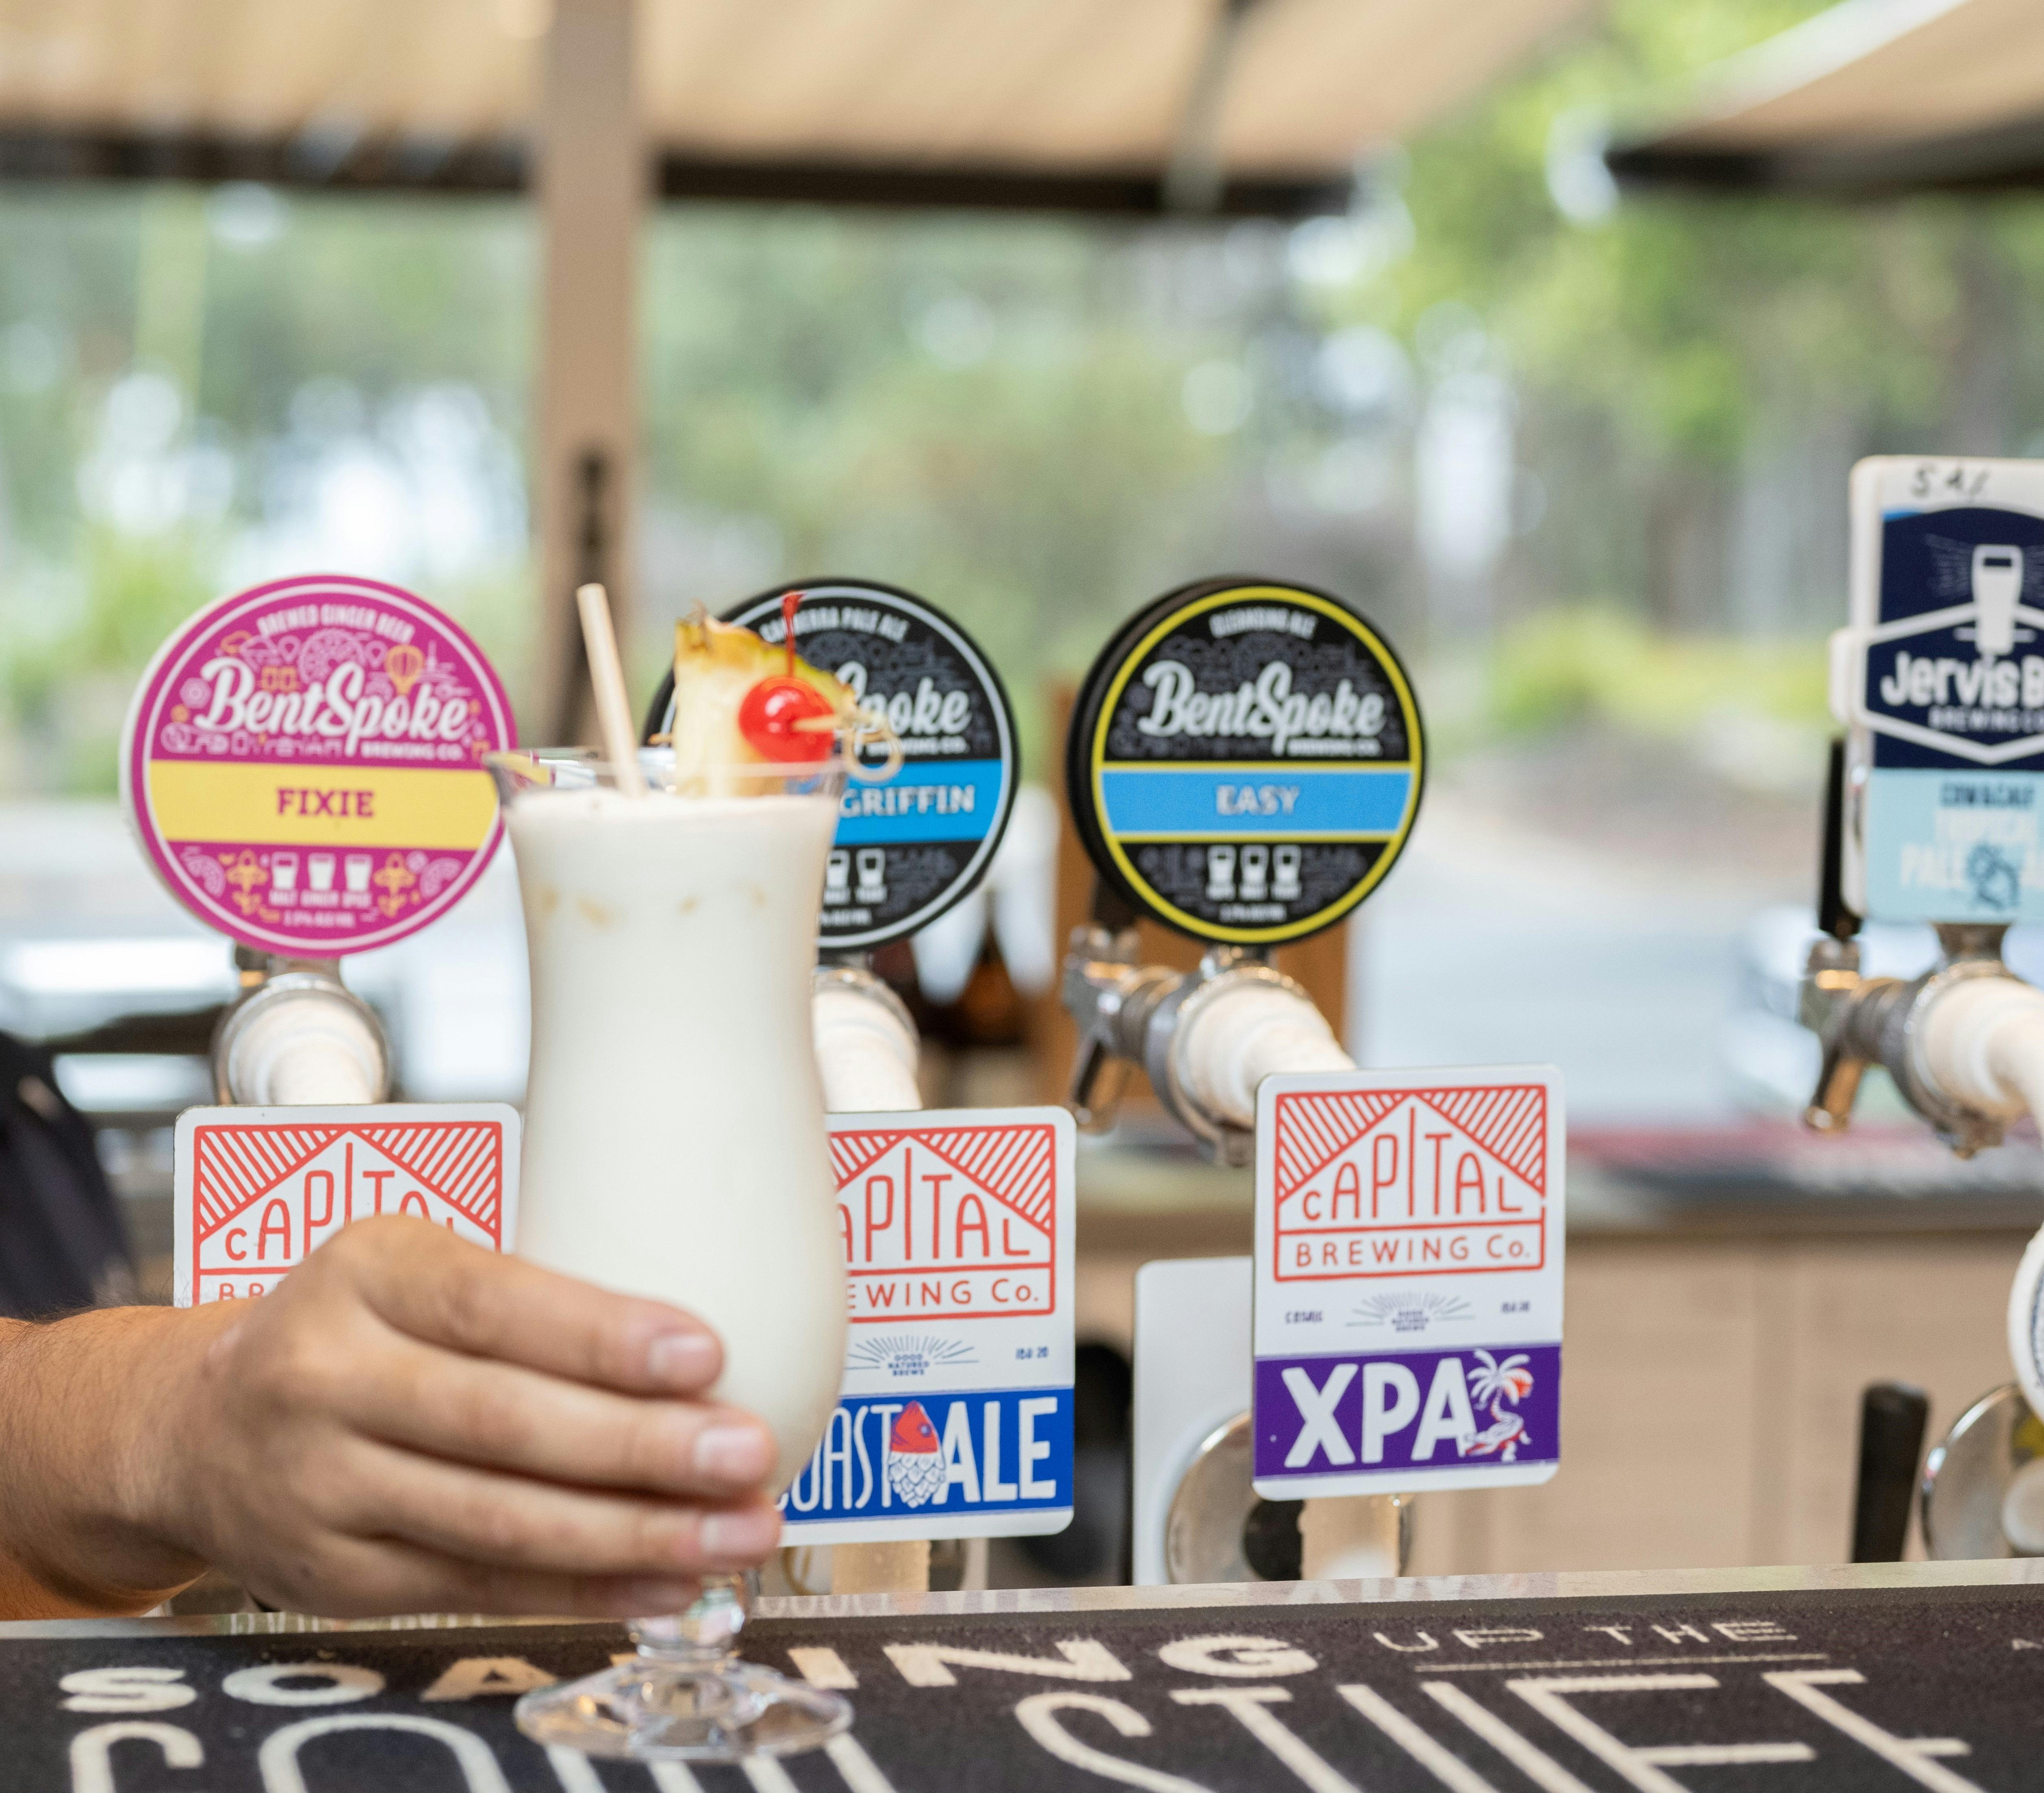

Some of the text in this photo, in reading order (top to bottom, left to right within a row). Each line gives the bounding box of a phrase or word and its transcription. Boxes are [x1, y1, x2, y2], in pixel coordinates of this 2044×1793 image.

[193, 657, 469, 758] BentSpoke
[1138, 660, 1384, 756] BentSpoke
[277, 787, 375, 818] FIXIE
[839, 784, 975, 818] GRIFFIN
[1215, 784, 1300, 815] EASY
[1303, 1106, 1522, 1220] CAPITAL
[1296, 1236, 1469, 1267] BREWING
[1281, 1357, 1478, 1468] XPA
[775, 1396, 1058, 1513] OAST ALE
[59, 1635, 1318, 1713] SOAING
[1374, 1621, 1798, 1652] UP THE
